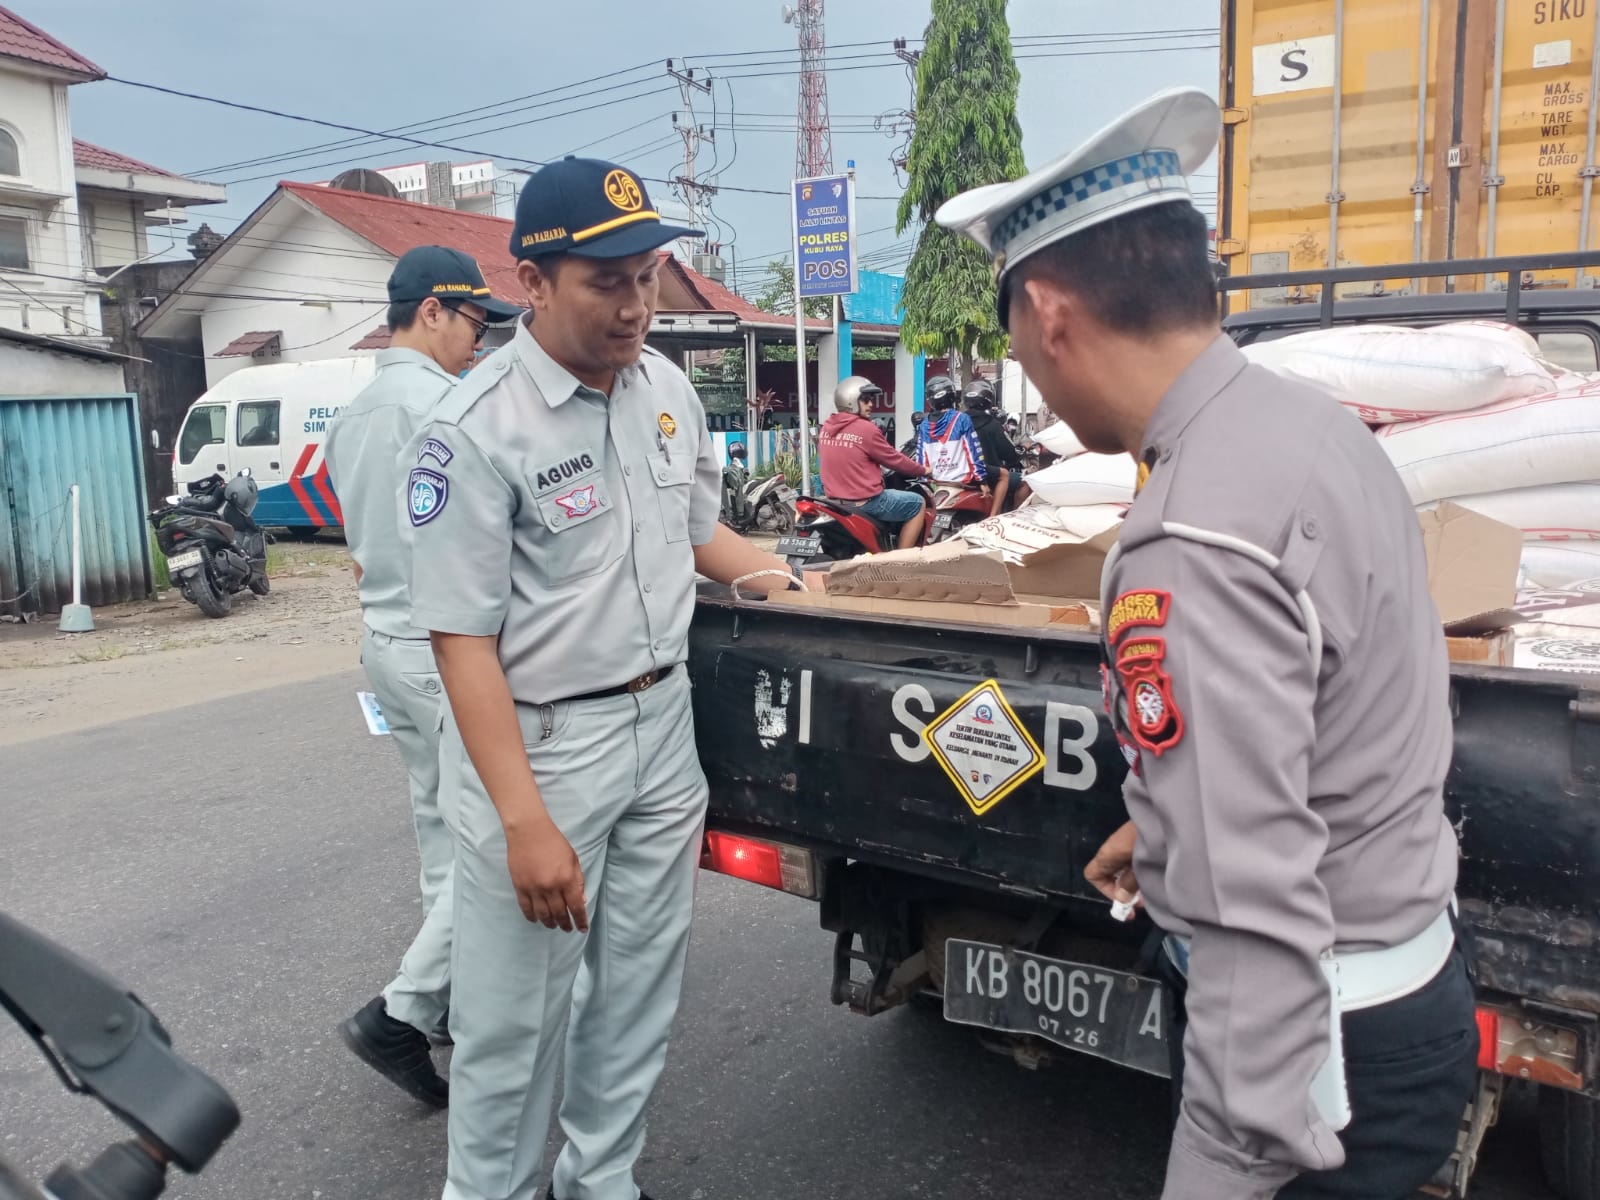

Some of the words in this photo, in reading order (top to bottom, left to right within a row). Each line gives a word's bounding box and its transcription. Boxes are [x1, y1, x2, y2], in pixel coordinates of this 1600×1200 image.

[1280, 49, 1308, 82] S
[1544, 81, 1575, 96] MAX.
[1543, 92, 1584, 107] GROSS
[1541, 110, 1574, 125] TARE
[1540, 124, 1573, 137] WGT.
[1539, 142, 1569, 156] MAX.
[1538, 154, 1578, 167] CARGO
[1536, 172, 1557, 185] CU.
[1535, 184, 1564, 197] CAP.
[807, 206, 838, 217] SATUAN
[799, 218, 819, 228] LALU
[819, 215, 847, 226] LINTAS
[534, 226, 568, 244] RAHARJA
[799, 231, 848, 246] POLRES
[804, 246, 824, 255] KUBU
[825, 244, 844, 253] RAYA
[803, 259, 848, 281] POS
[303, 421, 326, 433] SIM
[537, 453, 594, 490] AGUNG
[984, 738, 998, 747] YANG
[966, 947, 1009, 999] KB
[1023, 959, 1114, 1024] 8067
